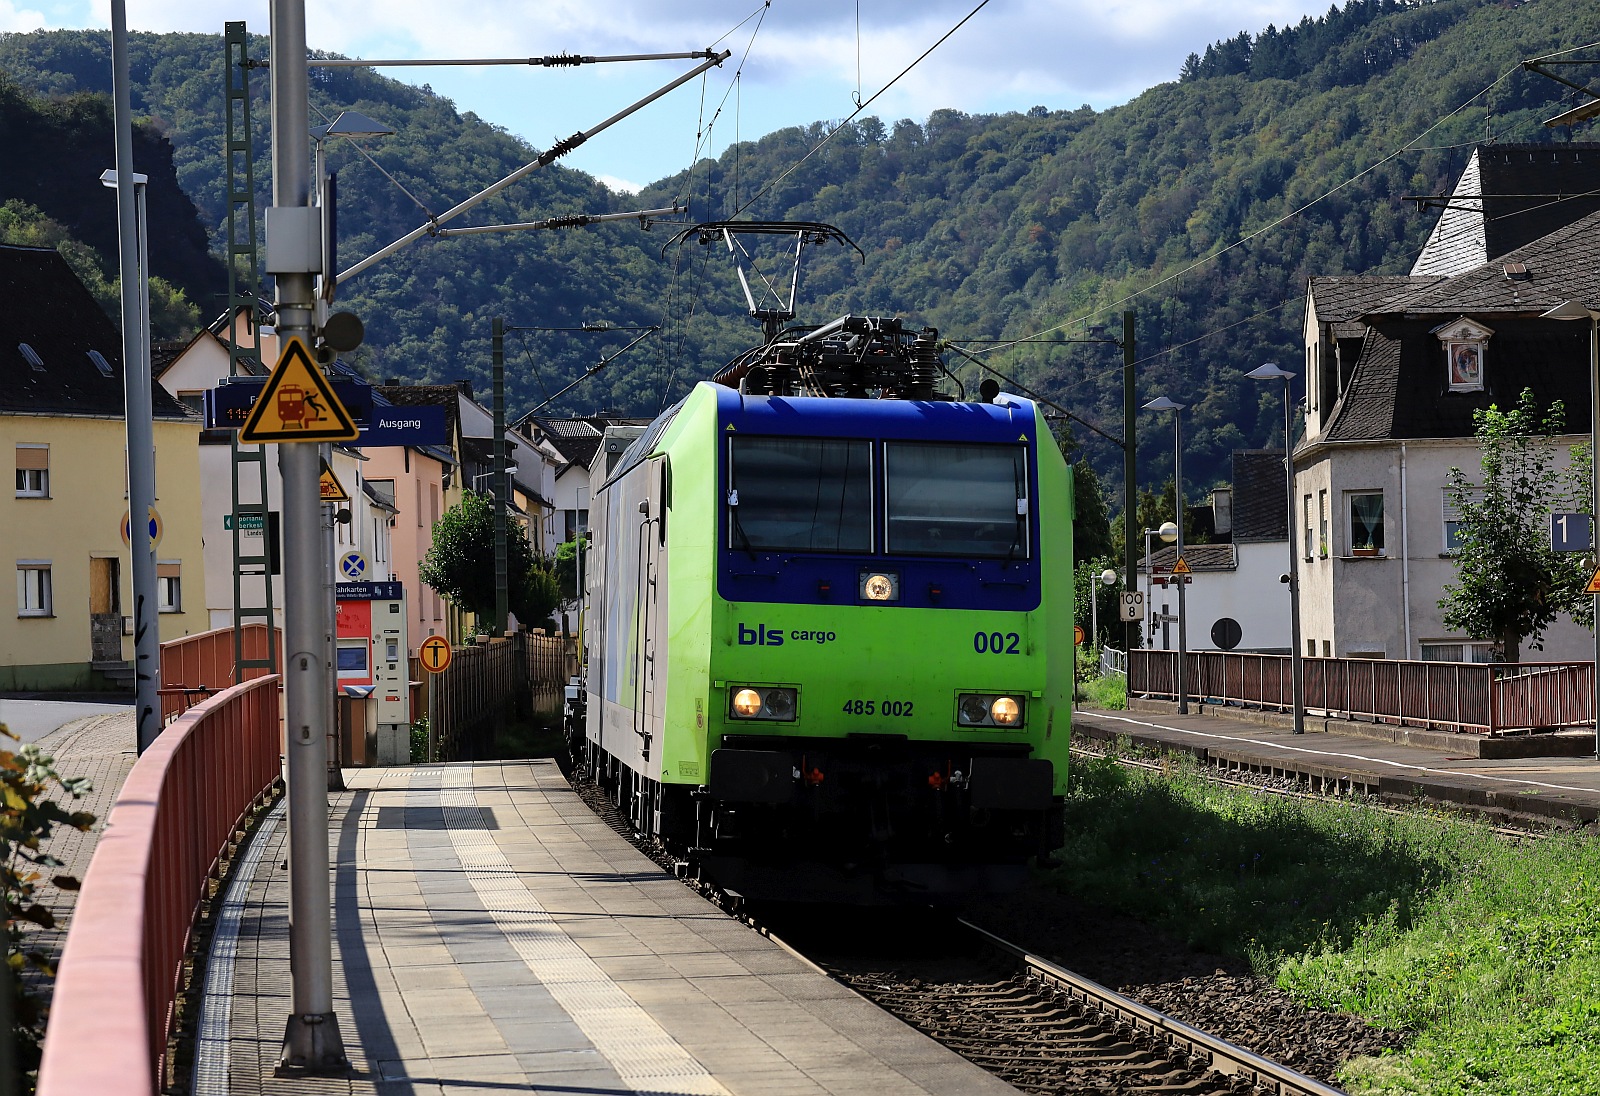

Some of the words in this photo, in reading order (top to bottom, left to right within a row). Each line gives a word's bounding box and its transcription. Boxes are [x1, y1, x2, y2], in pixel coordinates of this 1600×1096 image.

[379, 418, 421, 430] Ausgang
[1556, 516, 1567, 542] 1
[1121, 594, 1142, 604] 100
[1129, 606, 1135, 617] 8
[738, 622, 785, 646] bls
[790, 630, 836, 644] cargo
[973, 631, 1020, 655] 002
[842, 699, 876, 716] 485
[881, 700, 914, 717] 002
